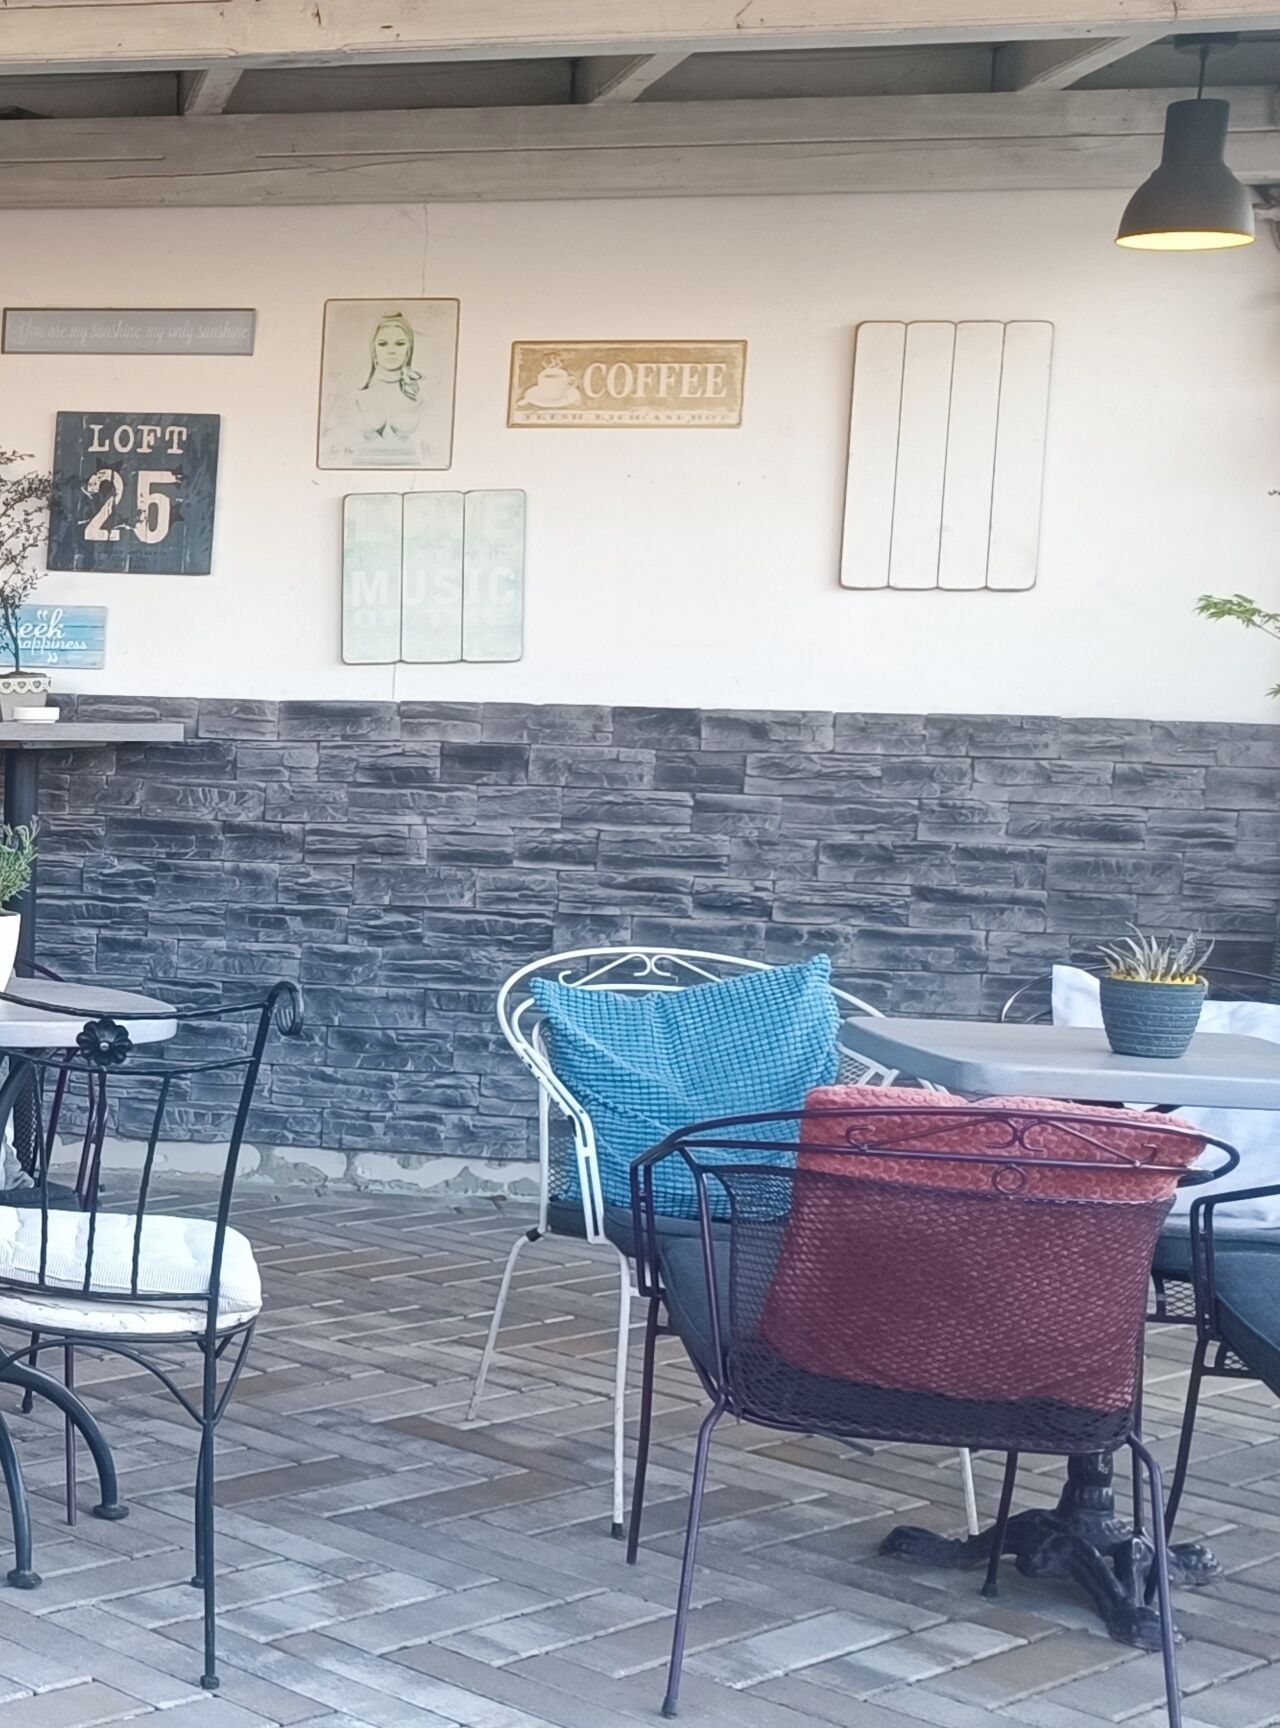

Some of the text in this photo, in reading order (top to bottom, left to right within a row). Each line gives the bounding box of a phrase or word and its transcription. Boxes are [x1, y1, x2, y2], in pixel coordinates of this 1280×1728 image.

[583, 362, 728, 399] COFFEE
[87, 424, 188, 455] LOFT
[84, 468, 178, 545] 25
[351, 567, 516, 607] MUSIC
[16, 608, 65, 639] eek
